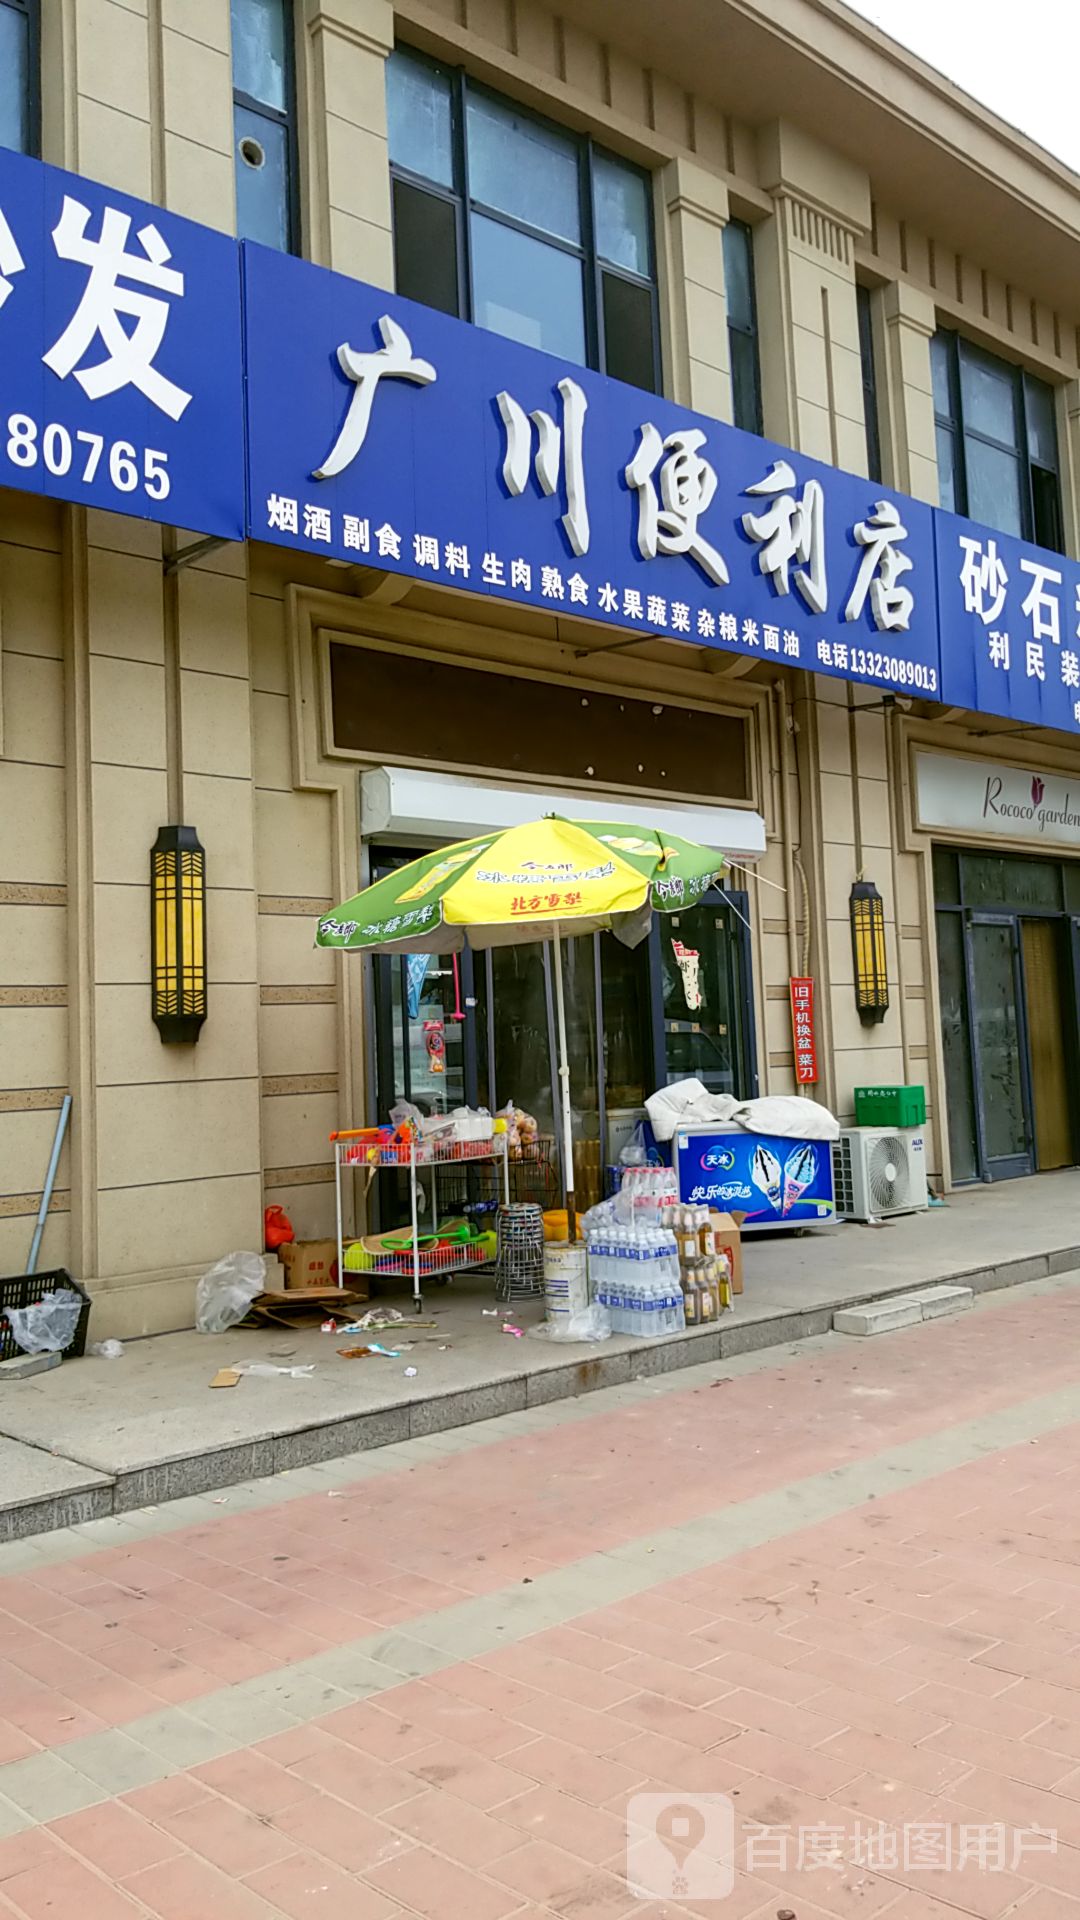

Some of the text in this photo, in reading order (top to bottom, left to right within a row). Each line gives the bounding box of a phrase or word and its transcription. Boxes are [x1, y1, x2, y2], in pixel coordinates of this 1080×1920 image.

[7, 413, 170, 500] 80765
[310, 314, 915, 632] 广川便利店
[267, 493, 332, 544] 烟酒
[343, 514, 402, 560] 副食
[413, 533, 471, 578] 调料
[482, 552, 532, 592] 生肉
[541, 566, 589, 606] 熟食
[598, 582, 691, 632] 水果蔬菜
[697, 608, 800, 658] 杂粮米面油
[983, 776, 1033, 820] Rococo
